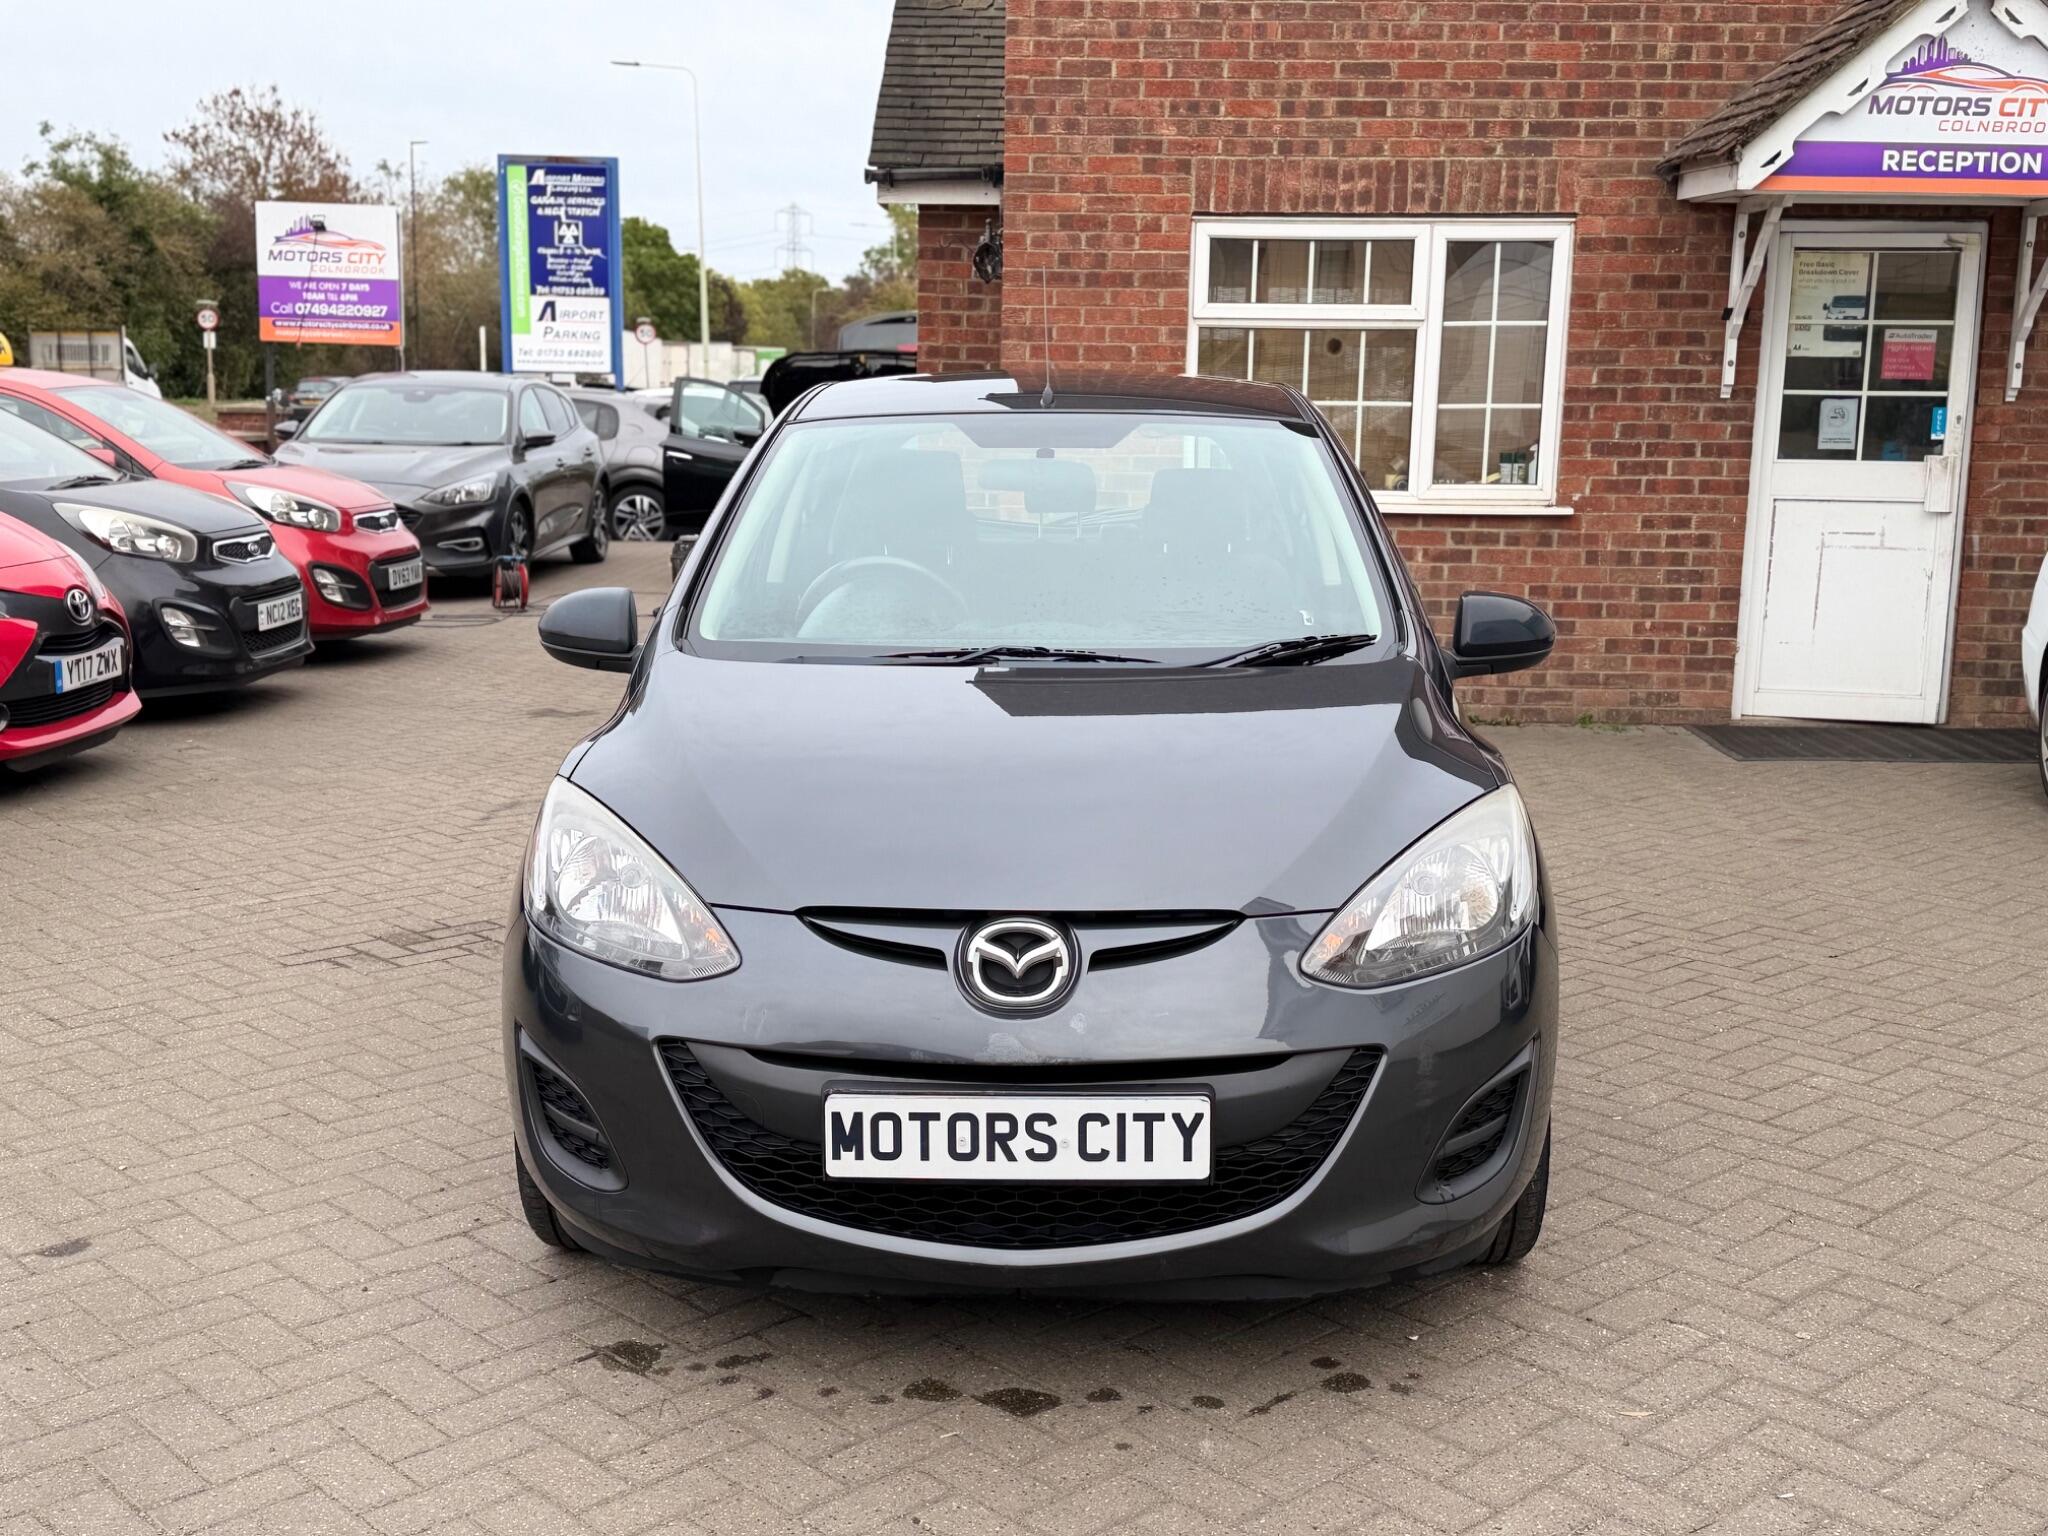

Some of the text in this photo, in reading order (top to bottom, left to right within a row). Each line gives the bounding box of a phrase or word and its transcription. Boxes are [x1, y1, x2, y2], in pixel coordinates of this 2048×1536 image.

[1867, 95, 2048, 118] MOTORS CIT
[1937, 119, 2047, 134] COLNBROO
[1881, 149, 2043, 174] RECEPTION
[268, 249, 386, 265] MOTORS CITY
[270, 302, 388, 317] Call 07494220927
[537, 300, 606, 322] AIRPORT
[543, 326, 601, 341] PARKING
[266, 597, 301, 625] NC12 XEG
[66, 648, 118, 684] YT17 ZWX
[831, 1111, 1204, 1162] MOTORS CITY
